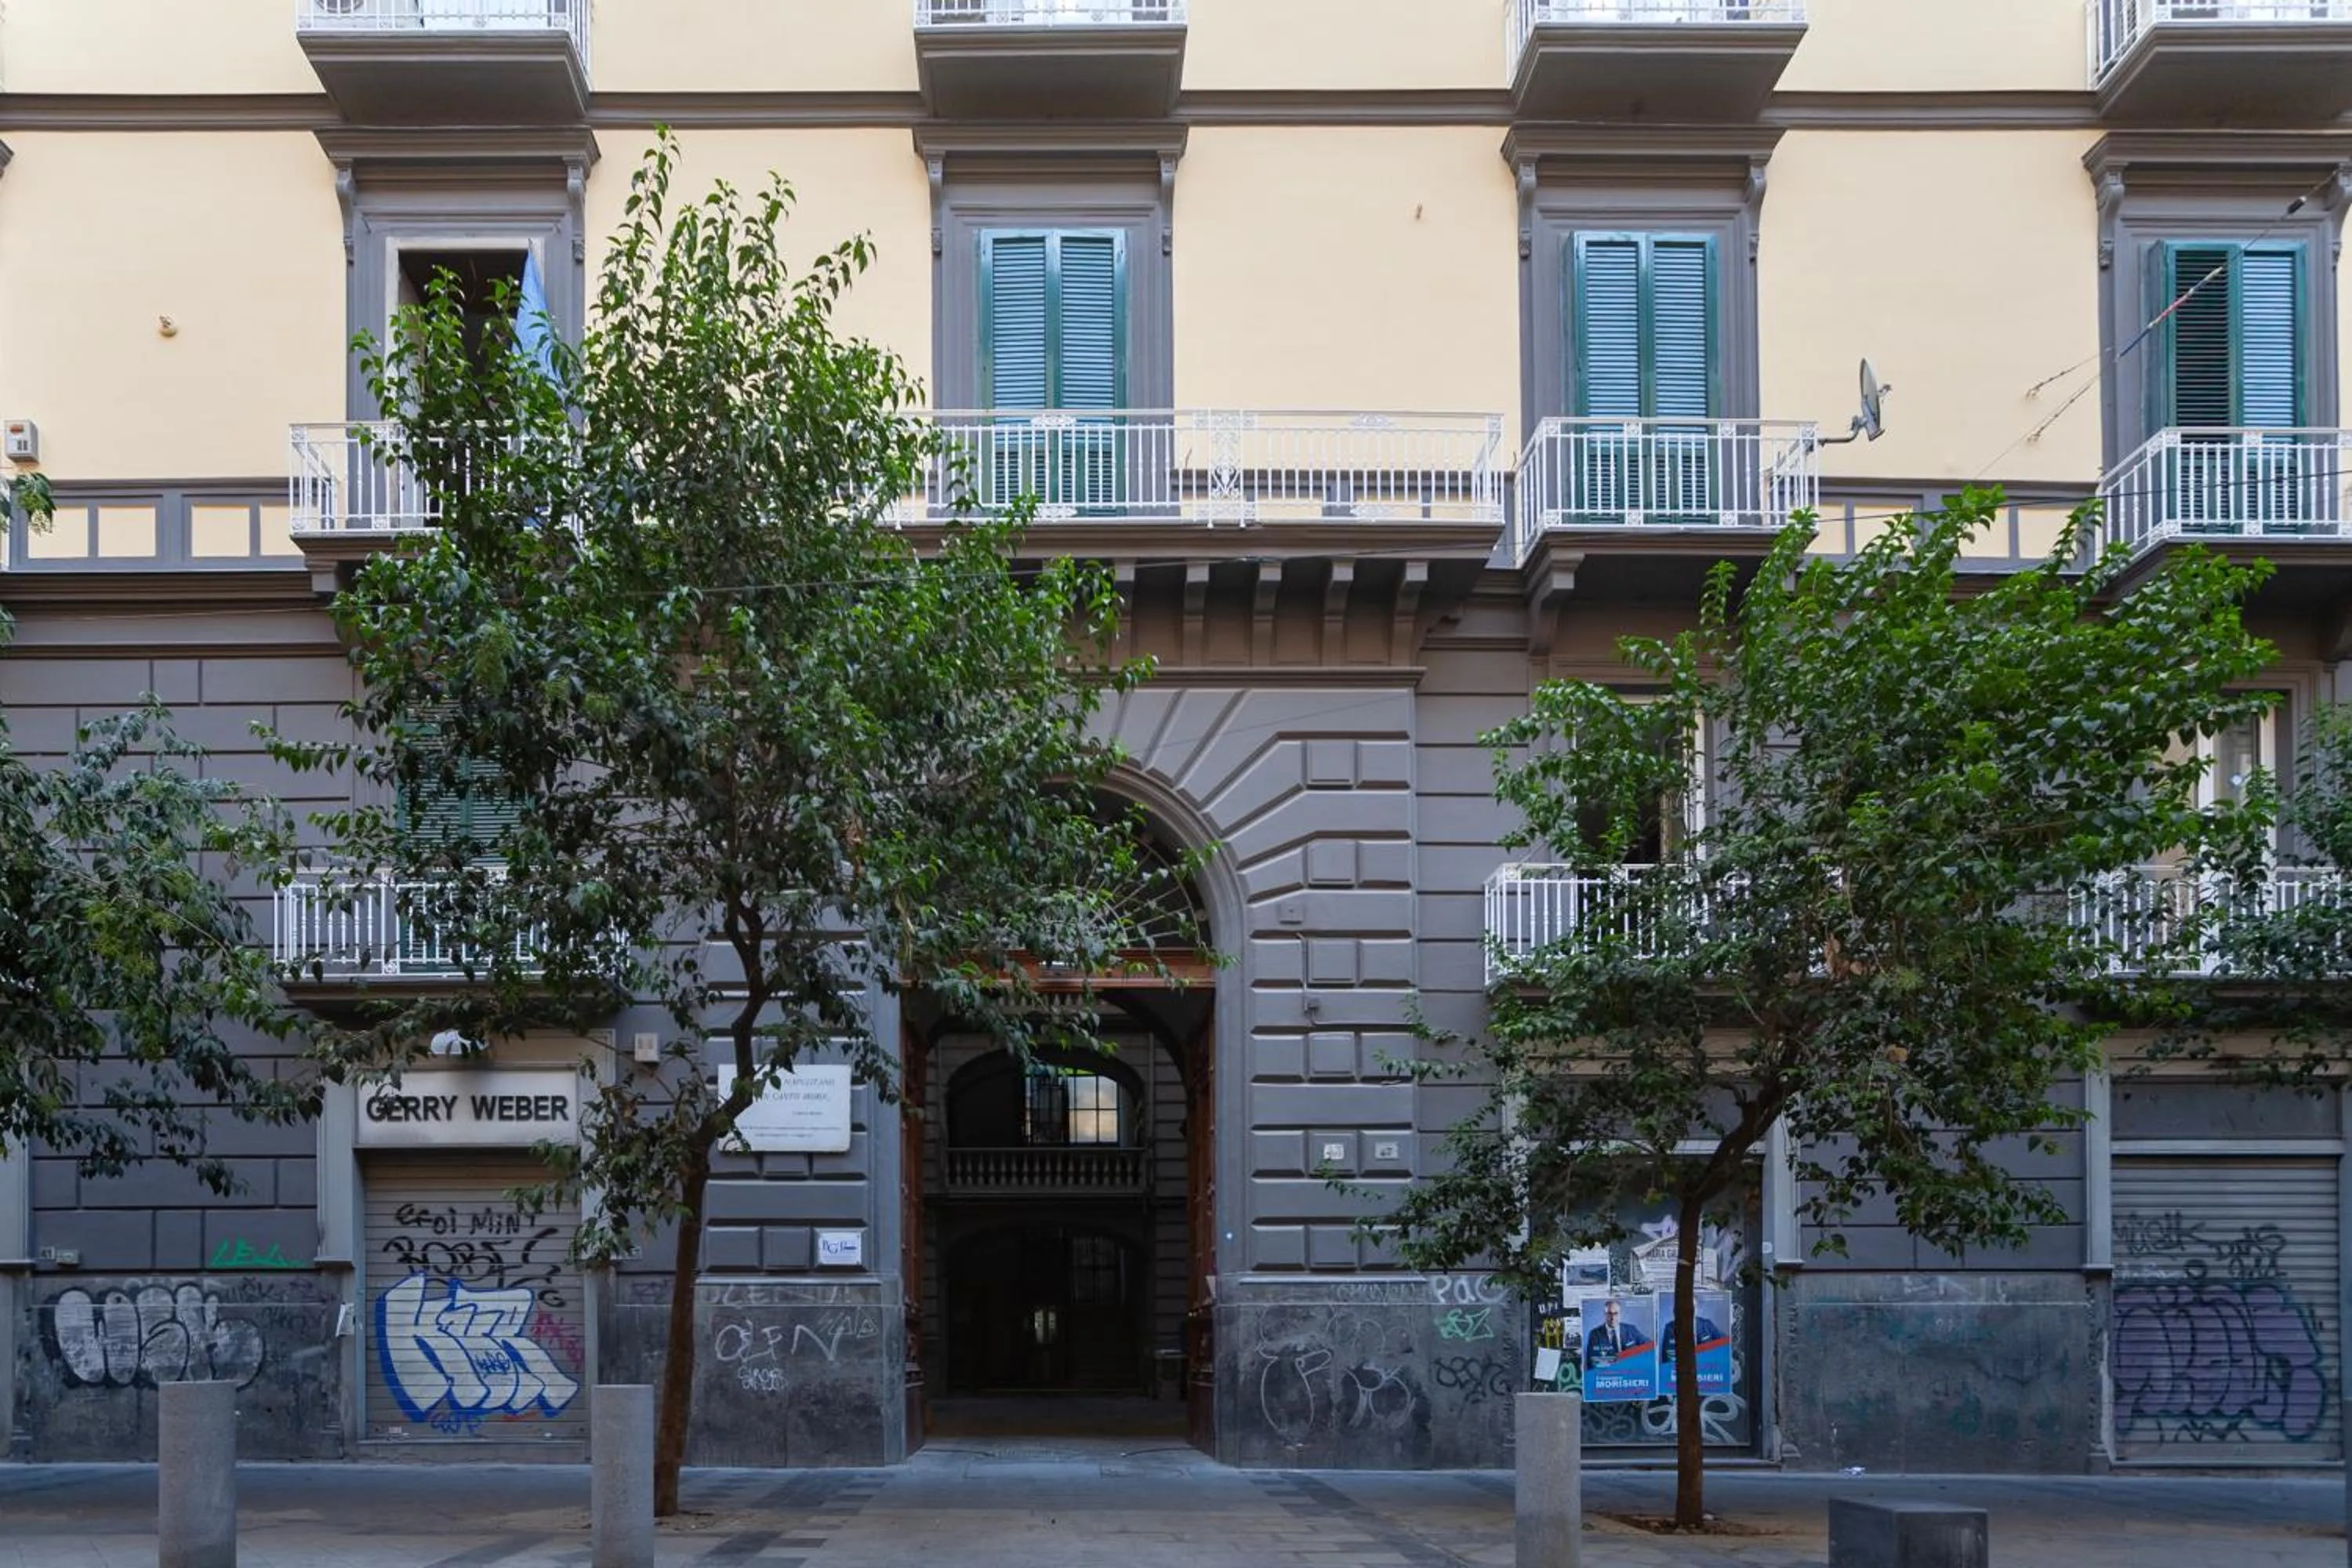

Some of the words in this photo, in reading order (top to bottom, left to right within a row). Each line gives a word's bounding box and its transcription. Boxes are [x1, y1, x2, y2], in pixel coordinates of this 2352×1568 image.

[366, 1094, 458, 1122] GERRY
[472, 1094, 569, 1122] WEBER
[1595, 1378, 1649, 1389] MORISIERI
